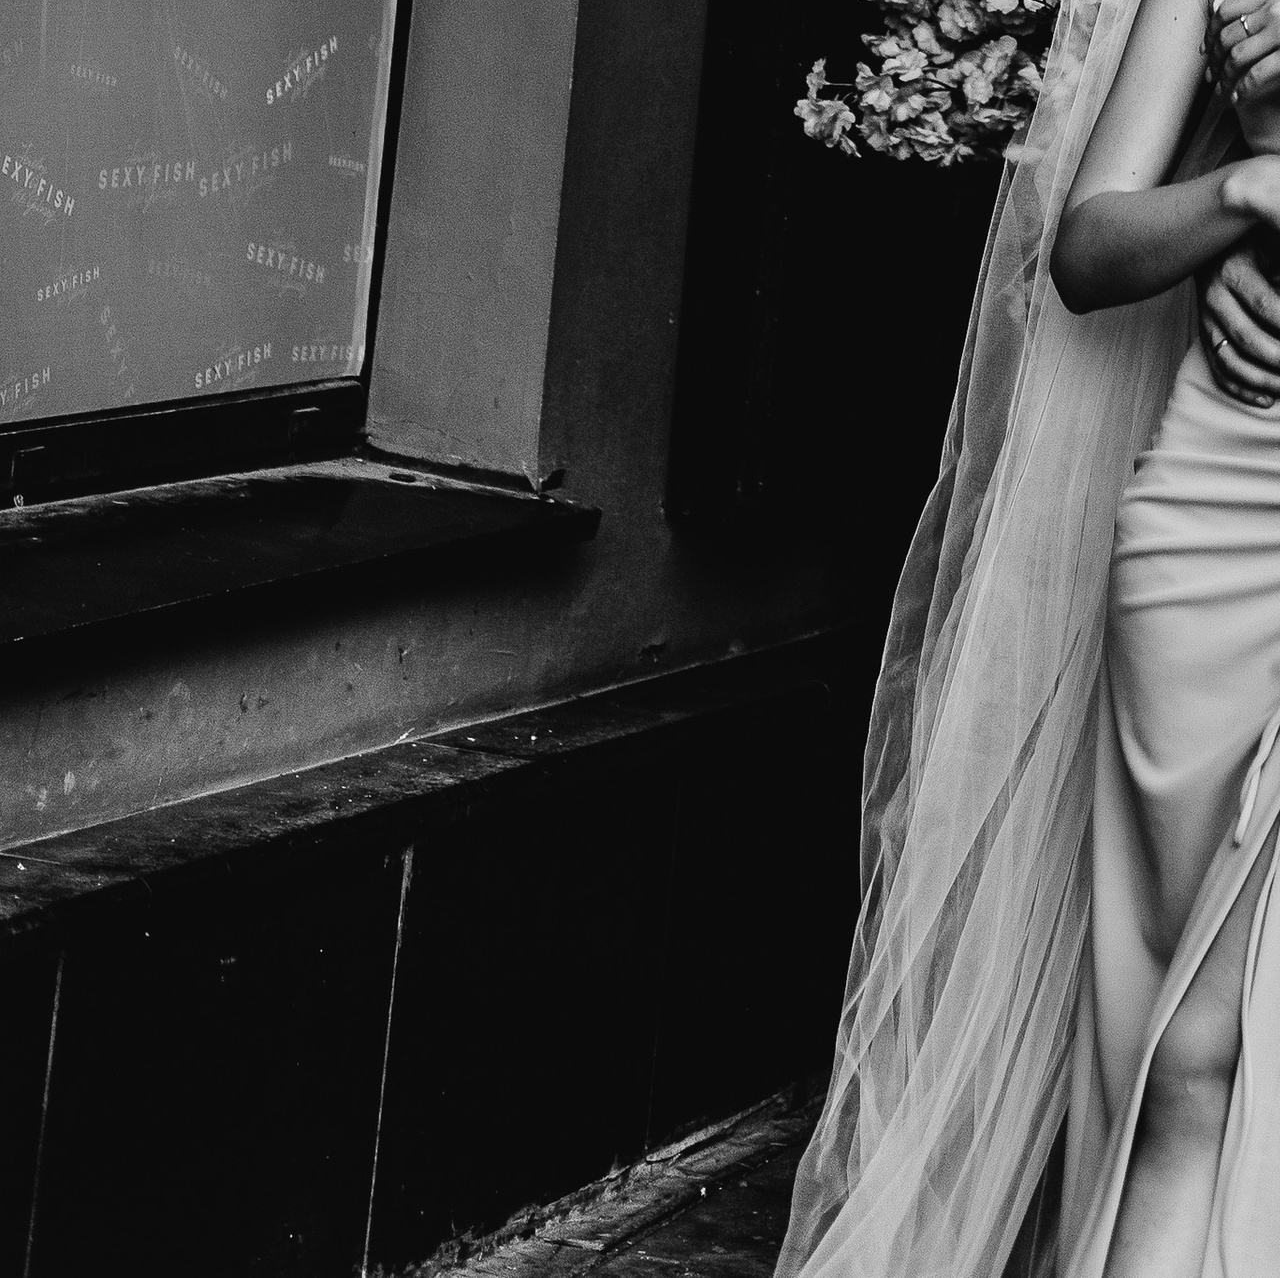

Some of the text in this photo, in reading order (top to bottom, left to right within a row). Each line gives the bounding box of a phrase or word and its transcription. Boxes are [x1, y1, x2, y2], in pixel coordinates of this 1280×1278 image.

[266, 65, 301, 105] SEXY
[305, 35, 339, 73] FISH
[2, 155, 33, 188] EXY
[37, 178, 75, 216] FISH
[99, 161, 195, 190] SEXY FISH
[199, 140, 293, 198] SEXY FISH
[37, 266, 100, 302] SEXY FISH
[246, 242, 326, 284] SEXY FISH
[195, 342, 272, 388] SEXY FISH
[291, 345, 327, 362] SEXY
[15, 366, 51, 399] FISH
